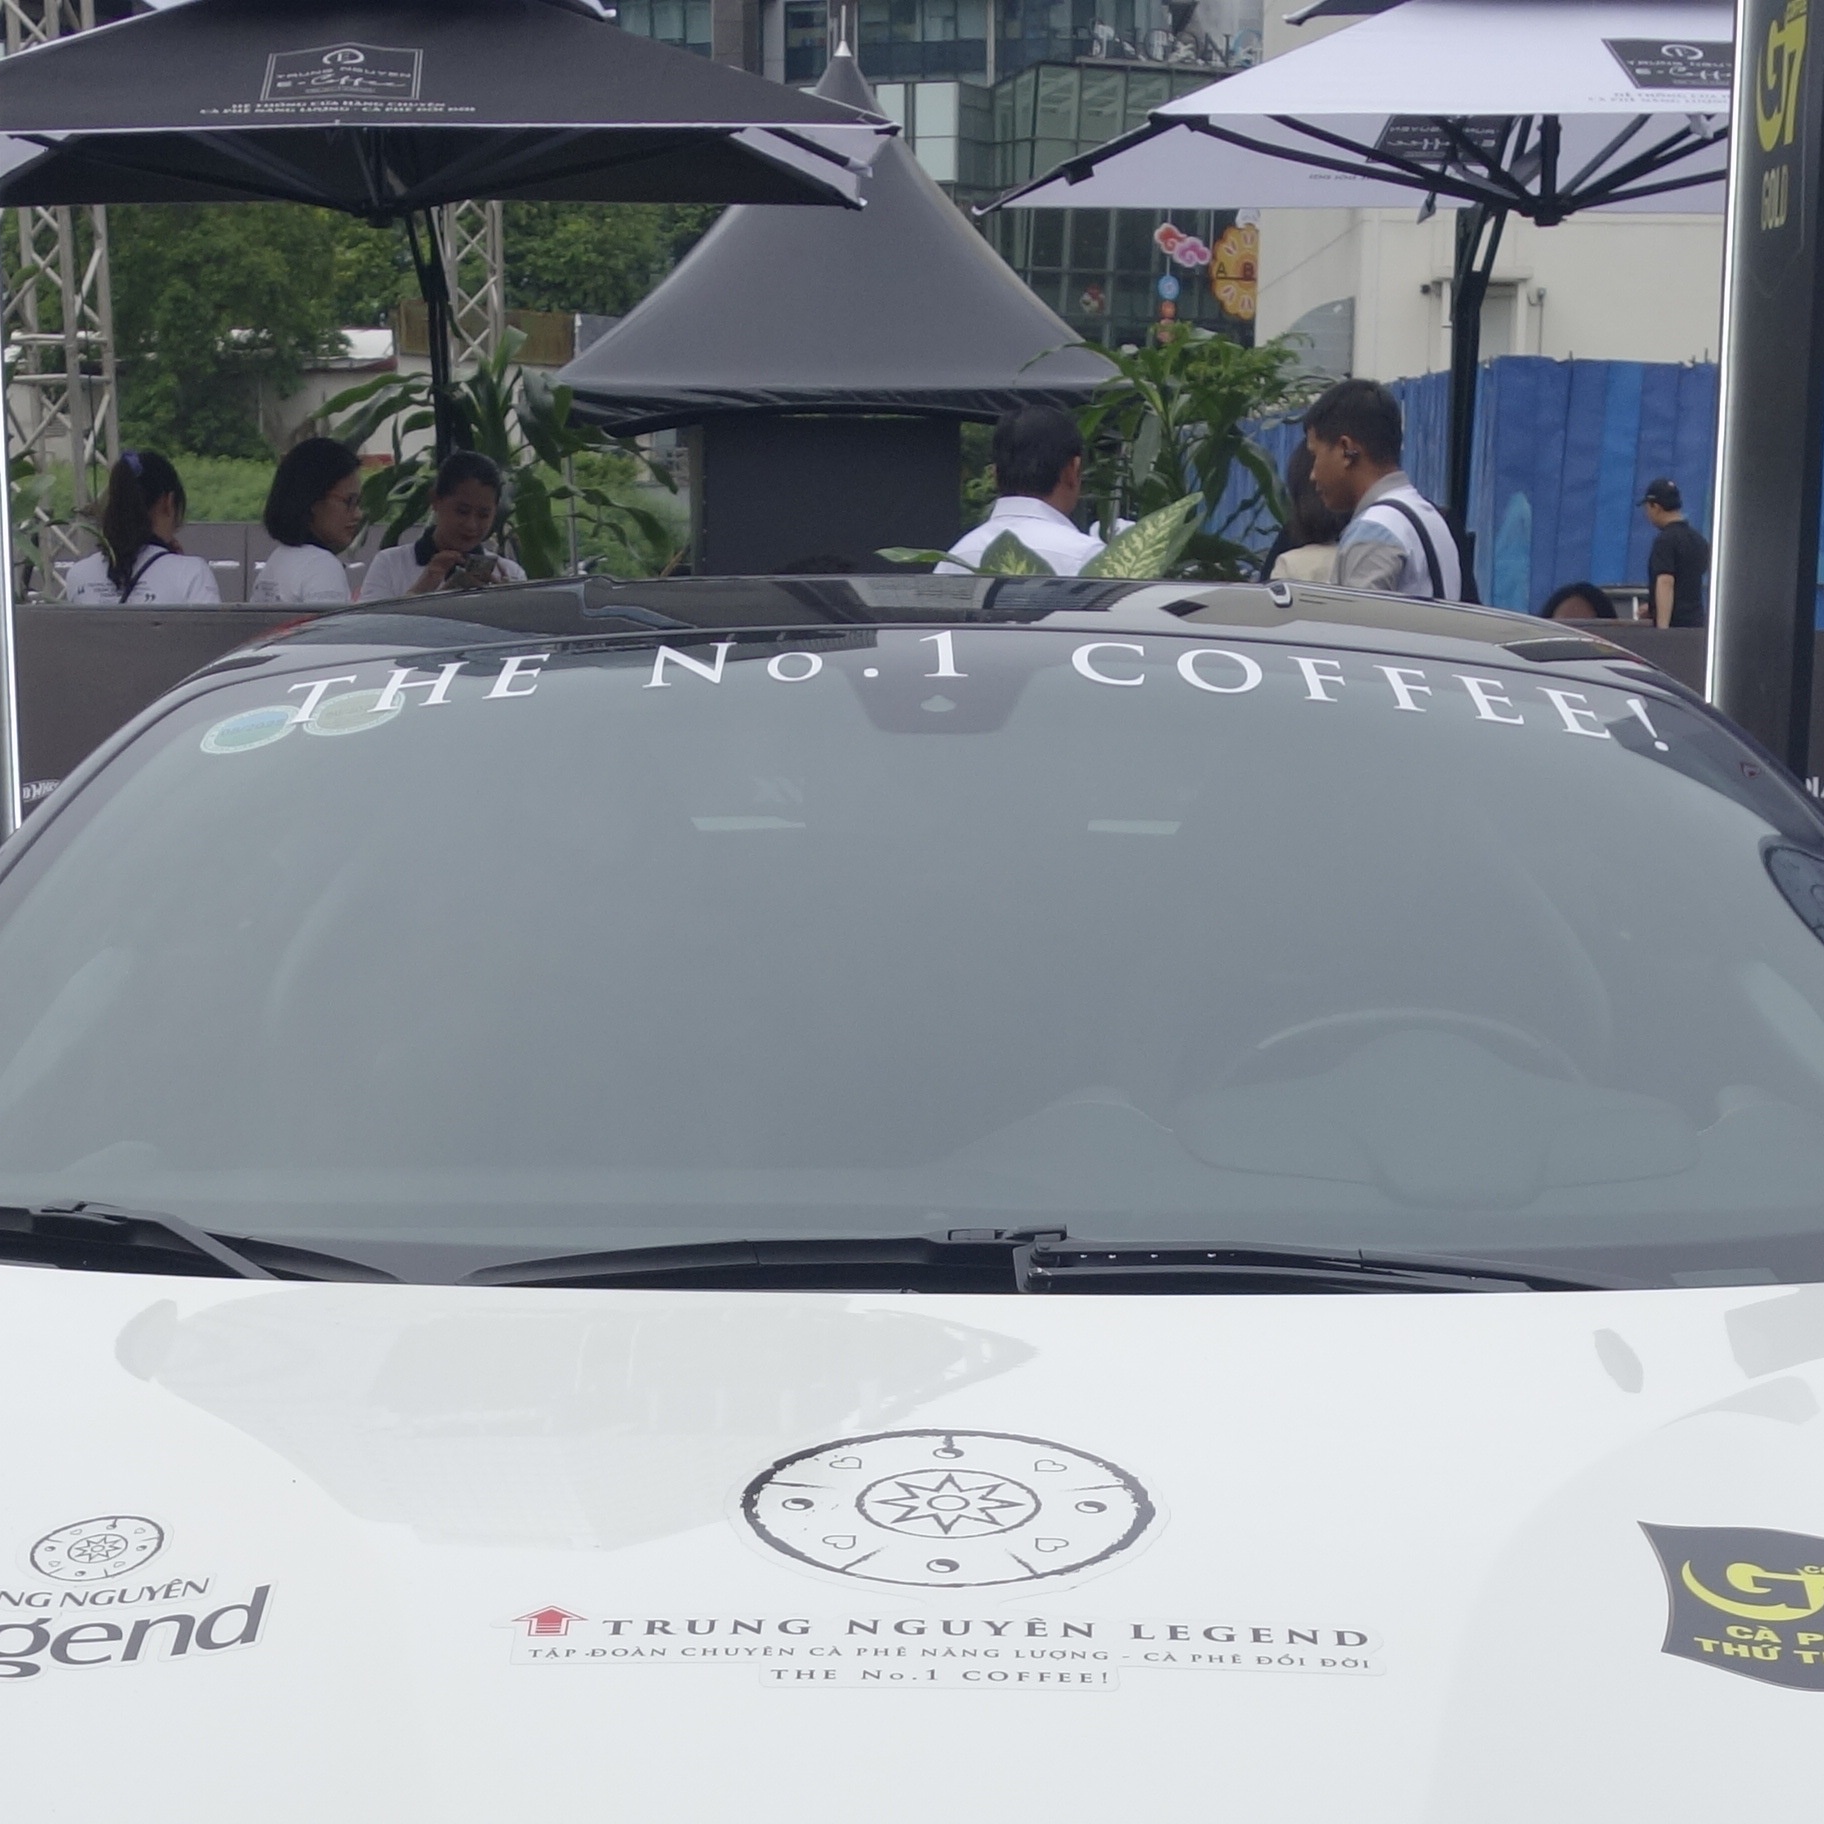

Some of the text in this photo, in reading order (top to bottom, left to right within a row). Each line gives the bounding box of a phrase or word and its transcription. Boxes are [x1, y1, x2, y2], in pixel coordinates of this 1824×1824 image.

[1757, 14, 1806, 151] G7
[1762, 164, 1788, 231] GOLD
[286, 629, 1670, 752] THE No.1 COFFEE!
[58, 1576, 211, 1609] NGUYÊN
[602, 1616, 1369, 1648] TRUNG NGUYÊN LEGEND
[1725, 1623, 1782, 1645] CÀ
[527, 1646, 577, 1661] TẬP
[681, 1643, 796, 1658] CHUYÊN
[809, 1644, 843, 1658] CÀ
[855, 1645, 908, 1658] PHÊ
[921, 1646, 1001, 1660] NĂNG
[1015, 1648, 1110, 1663] LƯỢNG
[1143, 1651, 1178, 1663] CÀ
[1190, 1651, 1243, 1665] PHÊ
[1319, 1656, 1370, 1670] ĐỜI
[1693, 1636, 1783, 1662] THỨ
[771, 1668, 1108, 1685] THE No.1 COFFEE!
